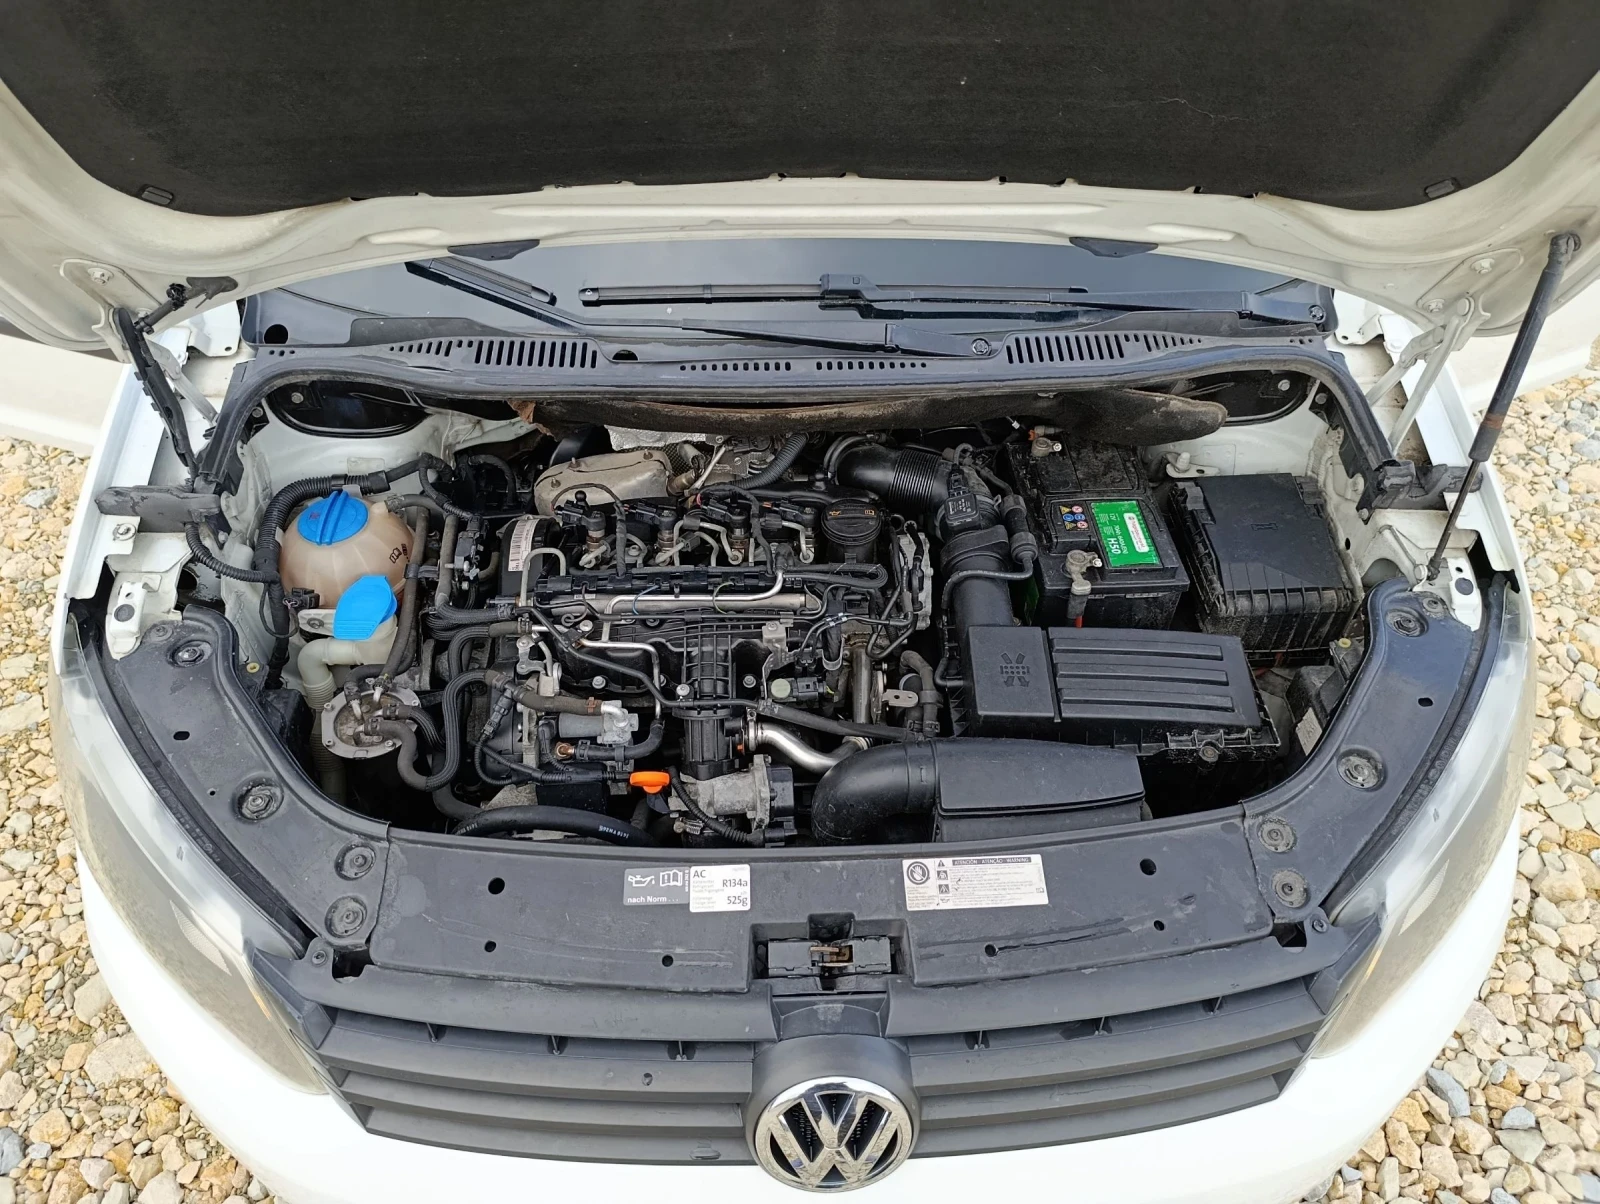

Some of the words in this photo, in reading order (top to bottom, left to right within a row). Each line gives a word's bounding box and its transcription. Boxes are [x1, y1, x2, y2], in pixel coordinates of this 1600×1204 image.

[1107, 538, 1121, 554] H50
[692, 869, 706, 879] AC
[722, 878, 748, 888] R134a
[627, 894, 646, 904] nach
[646, 895, 667, 903] Norm
[727, 895, 748, 907] 525g
